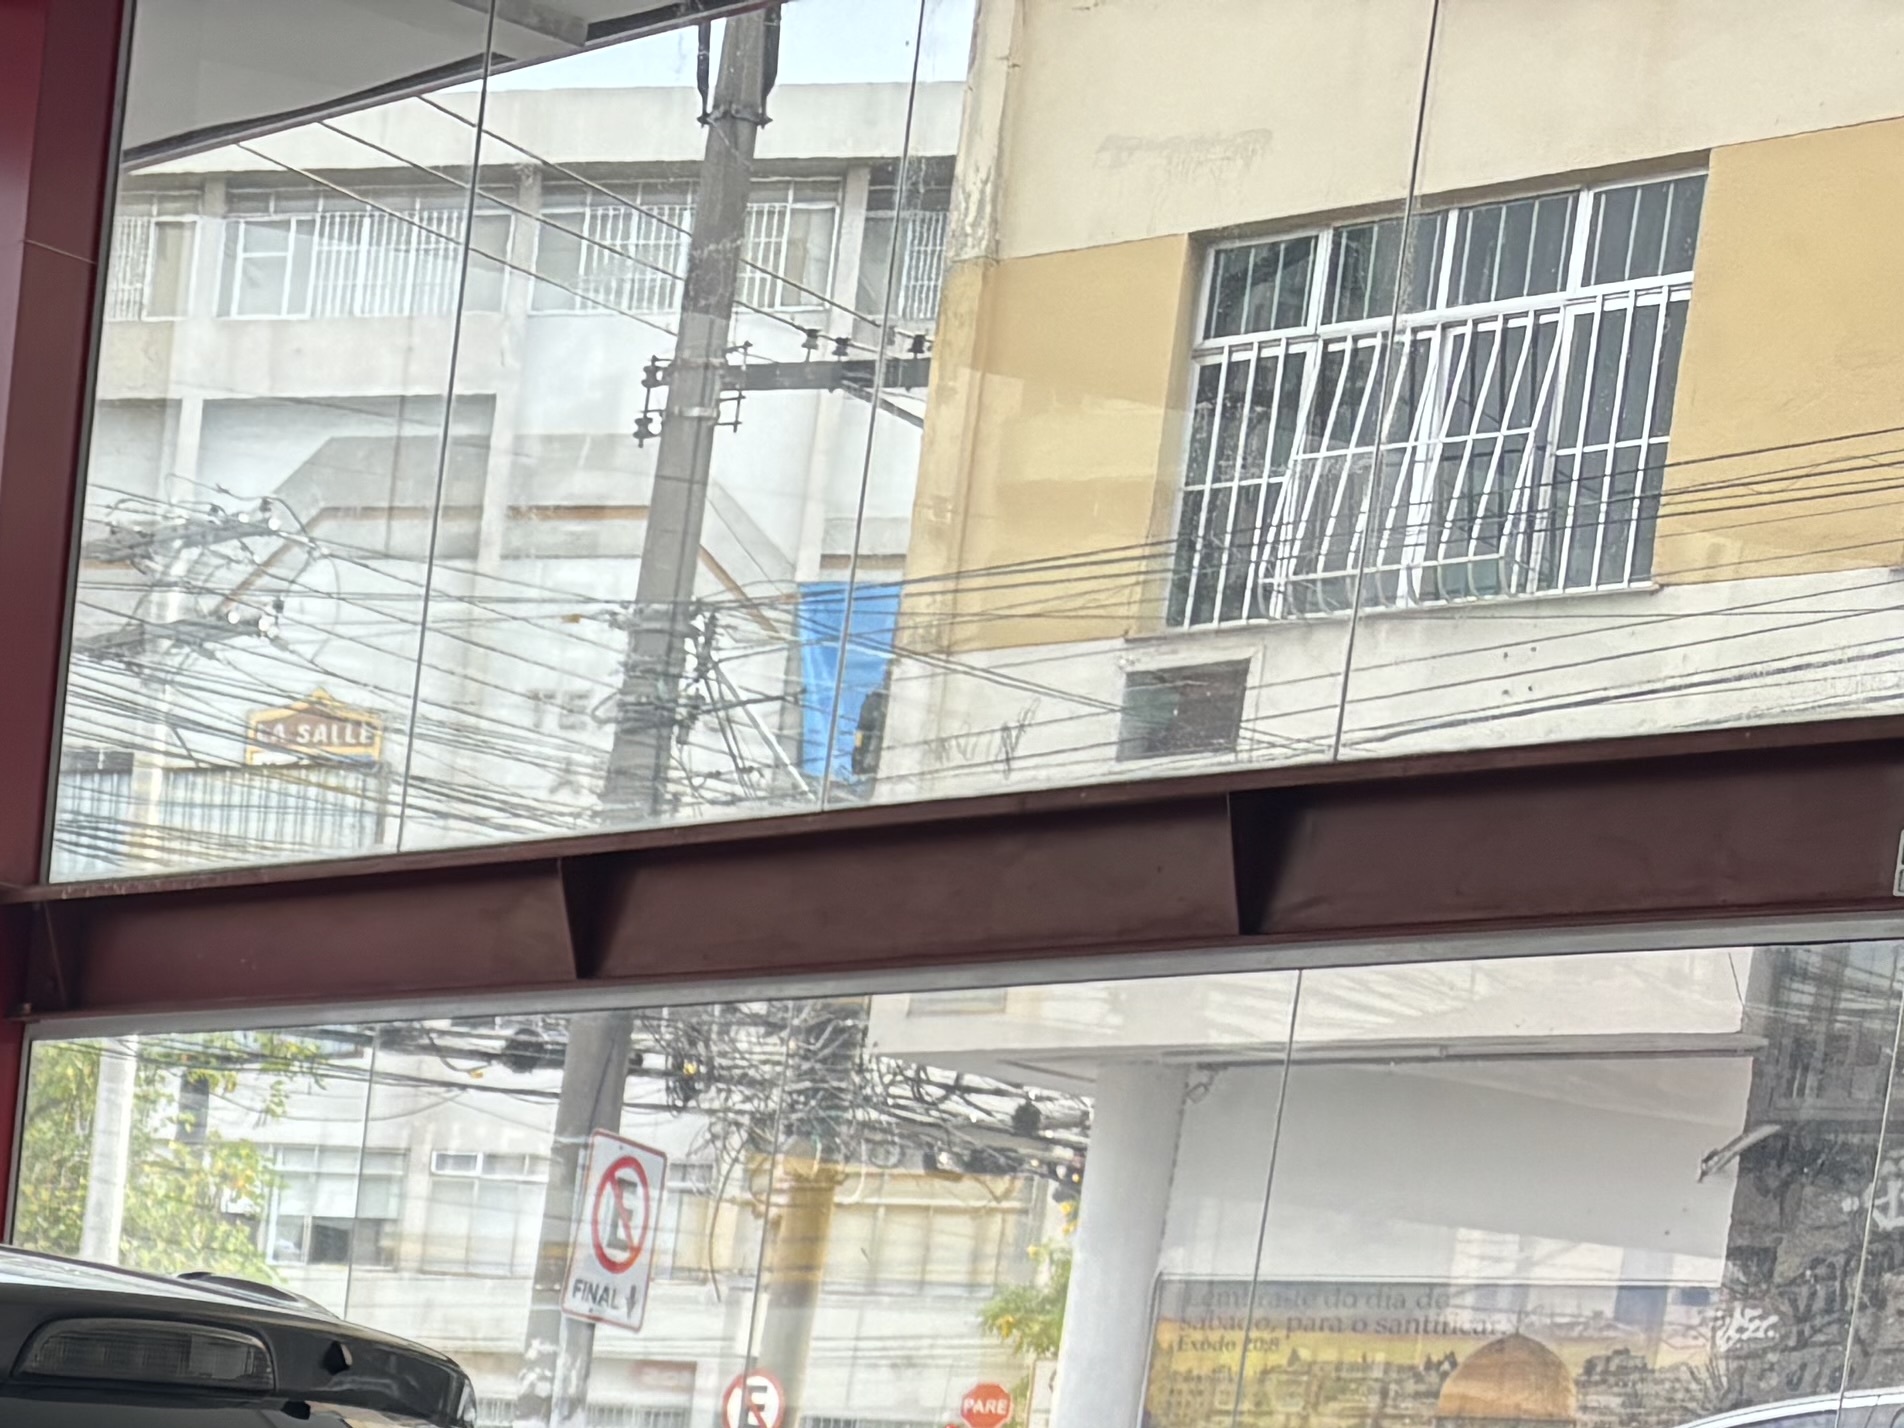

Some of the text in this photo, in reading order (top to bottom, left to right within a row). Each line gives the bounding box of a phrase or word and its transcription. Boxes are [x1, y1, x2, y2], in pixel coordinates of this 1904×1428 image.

[295, 722, 373, 745] SALLE
[571, 1278, 620, 1311] FINAL
[1286, 1316, 1342, 1340] para
[1352, 1318, 1368, 1333] o
[962, 1399, 1009, 1416] PARE
